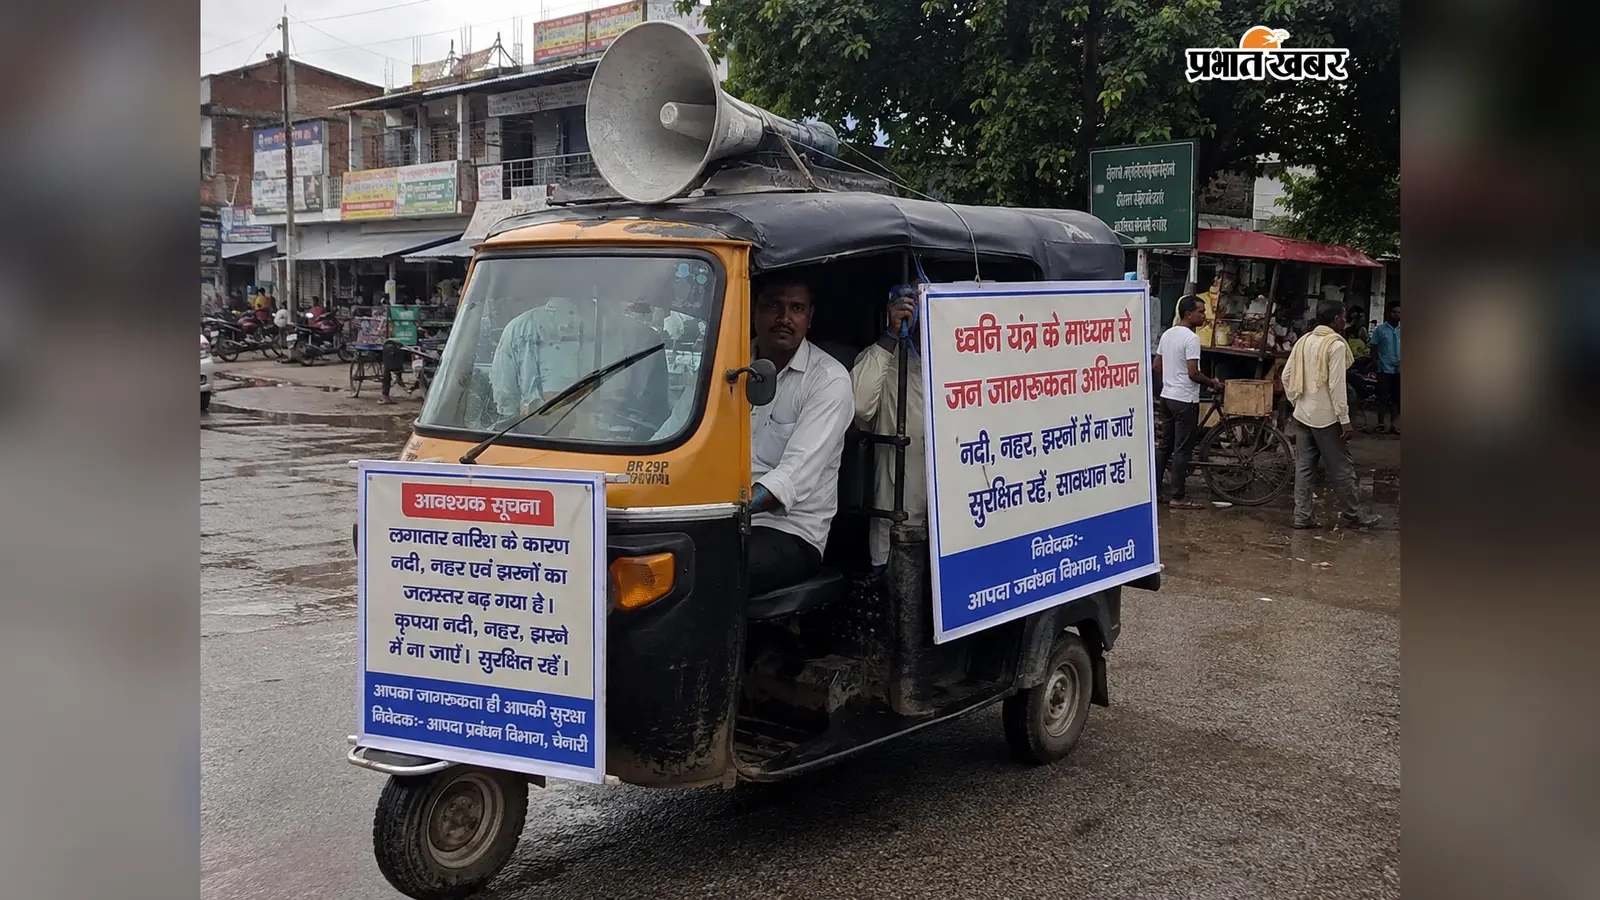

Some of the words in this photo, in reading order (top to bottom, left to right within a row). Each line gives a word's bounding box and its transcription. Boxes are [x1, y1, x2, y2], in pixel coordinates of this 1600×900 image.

[955, 313, 1002, 353] ध्वनि
[1007, 314, 1038, 353] यंत्र
[1042, 311, 1060, 347] के
[1065, 318, 1115, 345] माध्यम
[1119, 308, 1131, 342] से
[944, 379, 982, 409] जन
[987, 369, 1077, 404] जागरूकता
[1082, 355, 1140, 393] अभियान
[960, 430, 996, 465] नदी,
[1000, 432, 1036, 459] नहर,
[1041, 416, 1078, 454] झरनों
[1080, 414, 1092, 443] में
[1094, 419, 1108, 440] ना
[627, 461, 643, 471] BR
[646, 461, 669, 472] 29P
[414, 493, 487, 512] आवश्यक
[491, 497, 541, 521] सूचना
[968, 476, 1023, 528] सुरक्षित
[1027, 470, 1051, 503] रहें,
[1056, 464, 1107, 496] सावधान
[389, 528, 449, 545] लगातार
[452, 527, 497, 548] बारिश
[501, 530, 518, 550] के
[522, 536, 570, 554] कारण
[391, 552, 425, 574] नदी,
[431, 558, 466, 576] नहर
[469, 559, 493, 578] एवं
[497, 562, 541, 582] झरनों
[544, 568, 567, 584] का
[968, 582, 1010, 611] आपदा
[1060, 555, 1100, 581] विभाग,
[1104, 539, 1135, 566] चेनारी
[403, 585, 464, 604] जलस्तर
[468, 591, 491, 611] बढ़
[495, 593, 528, 610] गया
[395, 613, 439, 635] कृपया
[443, 614, 478, 637] नदी,
[484, 621, 523, 642] नहर,
[530, 625, 569, 644] झरने
[389, 636, 404, 656] में
[407, 643, 425, 658] ना
[478, 648, 533, 674] सुरक्षित
[373, 684, 414, 701] आपका
[416, 689, 483, 710] जागरूकता
[486, 693, 501, 713] ही
[504, 699, 546, 719] आपकी
[427, 717, 463, 734] आपदा
[505, 724, 548, 749] विभाग,
[552, 731, 588, 753] चेनारी
